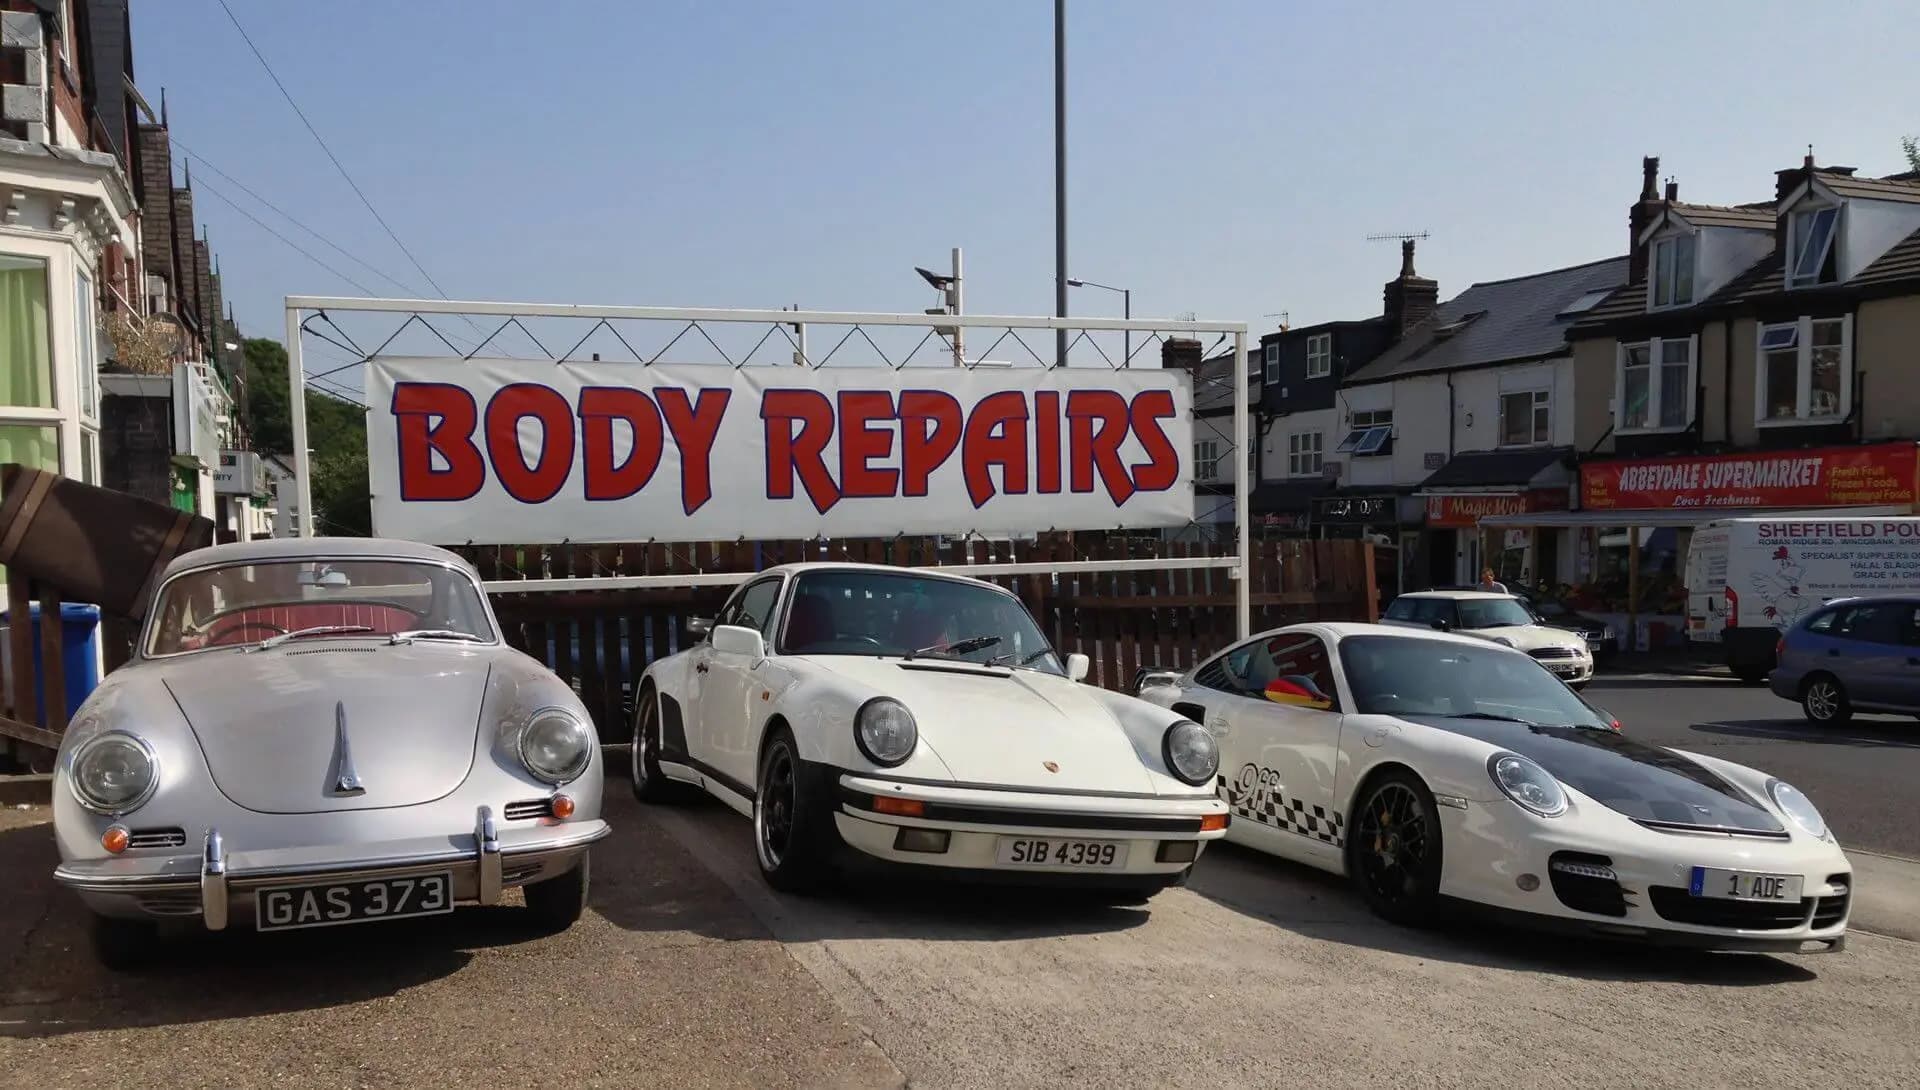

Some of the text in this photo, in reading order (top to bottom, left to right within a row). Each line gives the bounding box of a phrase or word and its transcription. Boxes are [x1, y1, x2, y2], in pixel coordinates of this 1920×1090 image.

[391, 381, 1180, 516] BODY REPAIRS
[1619, 457, 1823, 492] ABBEYDALE SUPERMARKET
[1450, 497, 1492, 517] Magic
[1672, 493, 1761, 506] Love Freshness
[1758, 523, 1876, 538] SHEFFIELD
[1800, 552, 1854, 560] SPECIALIST
[1857, 551, 1909, 560] SUPPLIERS
[1850, 561, 1881, 570] HALAL
[1854, 571, 1886, 579] GRADE
[1011, 841, 1116, 865] SIB 4399
[1727, 875, 1740, 896] 1
[1751, 876, 1786, 899] ADE
[267, 876, 445, 924] GAS 373
